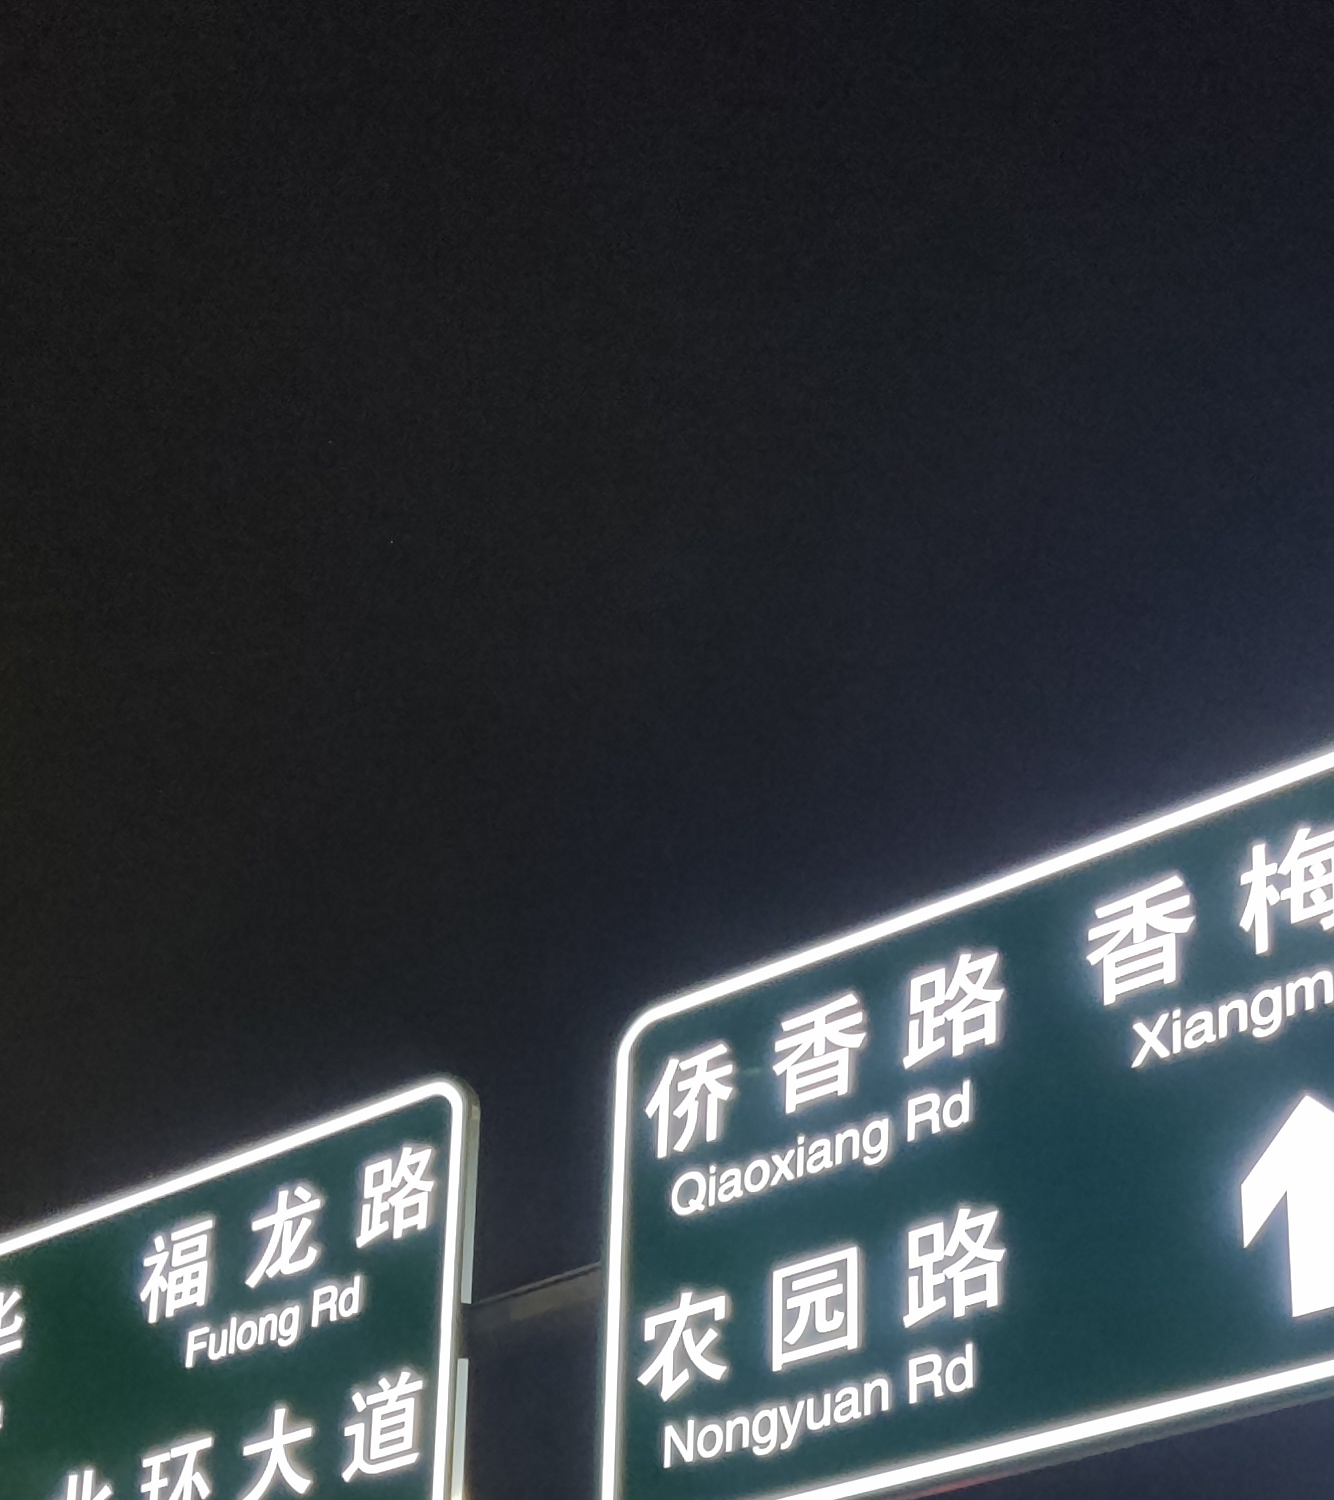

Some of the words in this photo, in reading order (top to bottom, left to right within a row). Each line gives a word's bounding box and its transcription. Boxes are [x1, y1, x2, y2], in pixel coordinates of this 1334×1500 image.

[643, 951, 1007, 1160] 侨香路
[670, 1115, 890, 1218] Qiaoxiang
[906, 1079, 972, 1143] Rd
[139, 1144, 435, 1324] 福龙路
[636, 1207, 1008, 1401] 农园路
[183, 1303, 301, 1369] Fulong
[310, 1274, 362, 1328] Rd
[663, 1377, 890, 1469] Nongyuan
[908, 1342, 975, 1405] Rd
